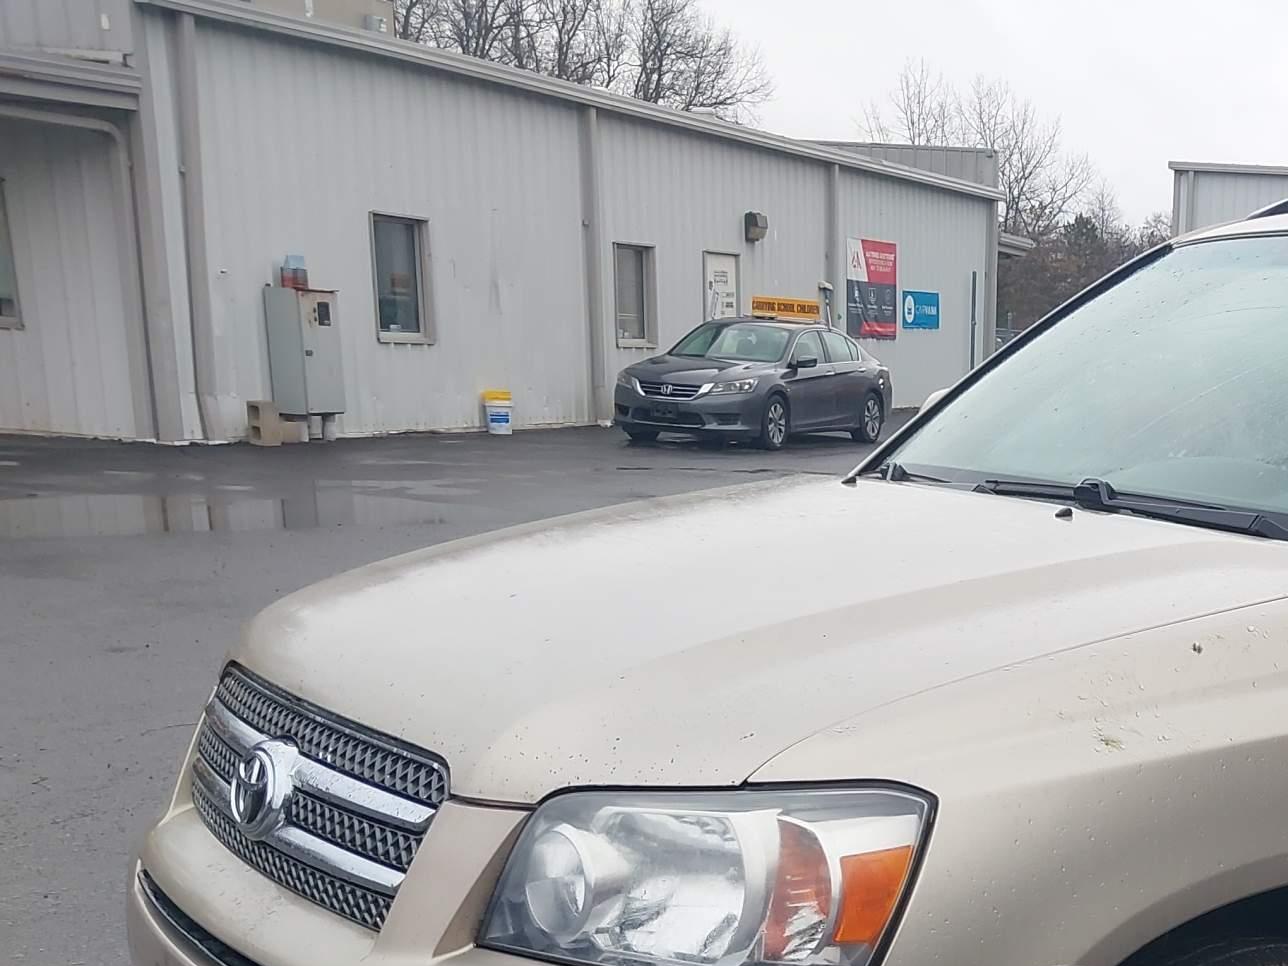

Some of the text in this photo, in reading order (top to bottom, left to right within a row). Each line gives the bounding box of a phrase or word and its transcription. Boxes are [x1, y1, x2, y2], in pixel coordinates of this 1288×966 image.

[752, 300, 820, 315] CARRYING SCHOOL CHILDREN
